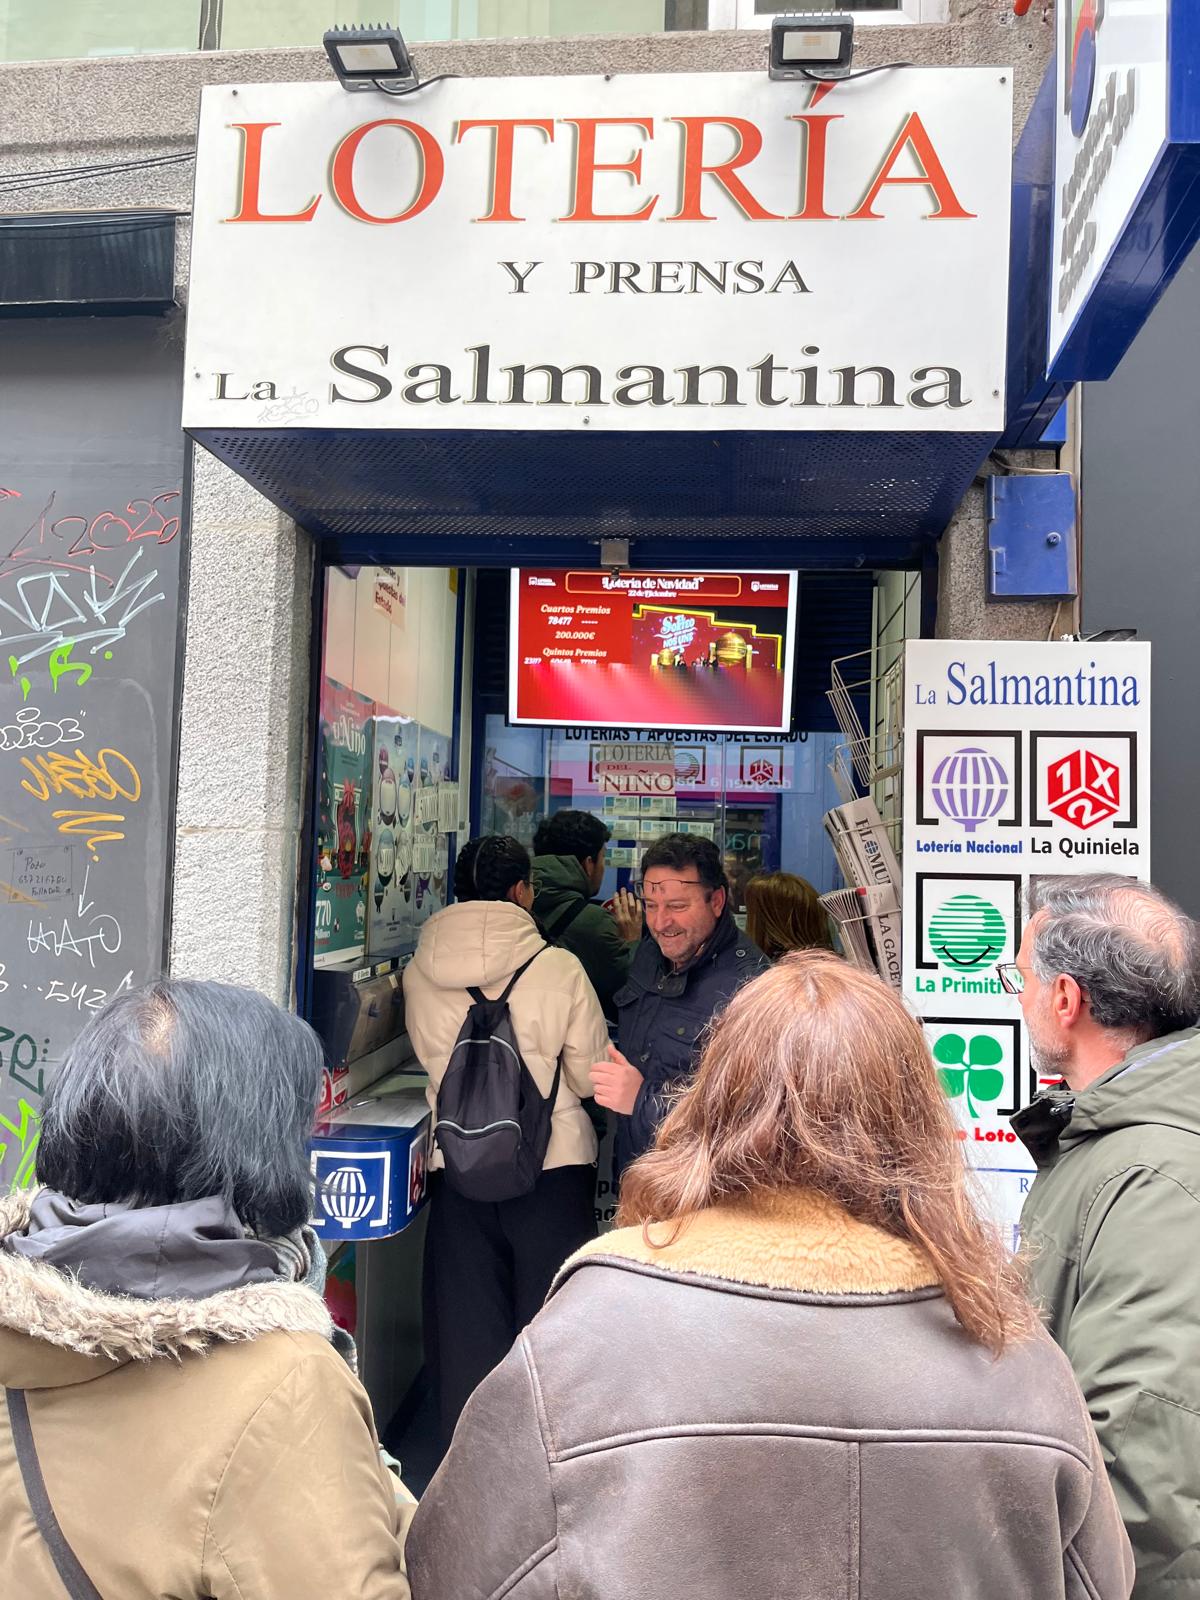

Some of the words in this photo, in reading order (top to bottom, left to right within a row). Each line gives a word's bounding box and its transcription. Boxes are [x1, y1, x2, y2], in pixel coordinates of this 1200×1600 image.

[219, 82, 979, 224] LOTERÍA
[498, 259, 543, 294] Y
[568, 259, 813, 295] PRENSA
[212, 372, 280, 401] La
[329, 342, 975, 411] Salmantina
[541, 604, 575, 614] Cuartos
[576, 604, 611, 615] Premios
[555, 631, 595, 640] 200.000€
[543, 647, 574, 657] Quintos
[575, 649, 607, 657] Premios
[915, 684, 937, 705] La
[946, 660, 1140, 706] Salmantina
[603, 769, 674, 792] NIÑO
[916, 839, 963, 853] Lotería
[966, 840, 1023, 854] Nacional
[1031, 838, 1052, 854] La
[1058, 837, 1140, 858] Quiniela
[878, 914, 891, 936] LA
[915, 976, 936, 993] La
[942, 977, 1002, 995] Primiti
[974, 1127, 1017, 1143] Loto
